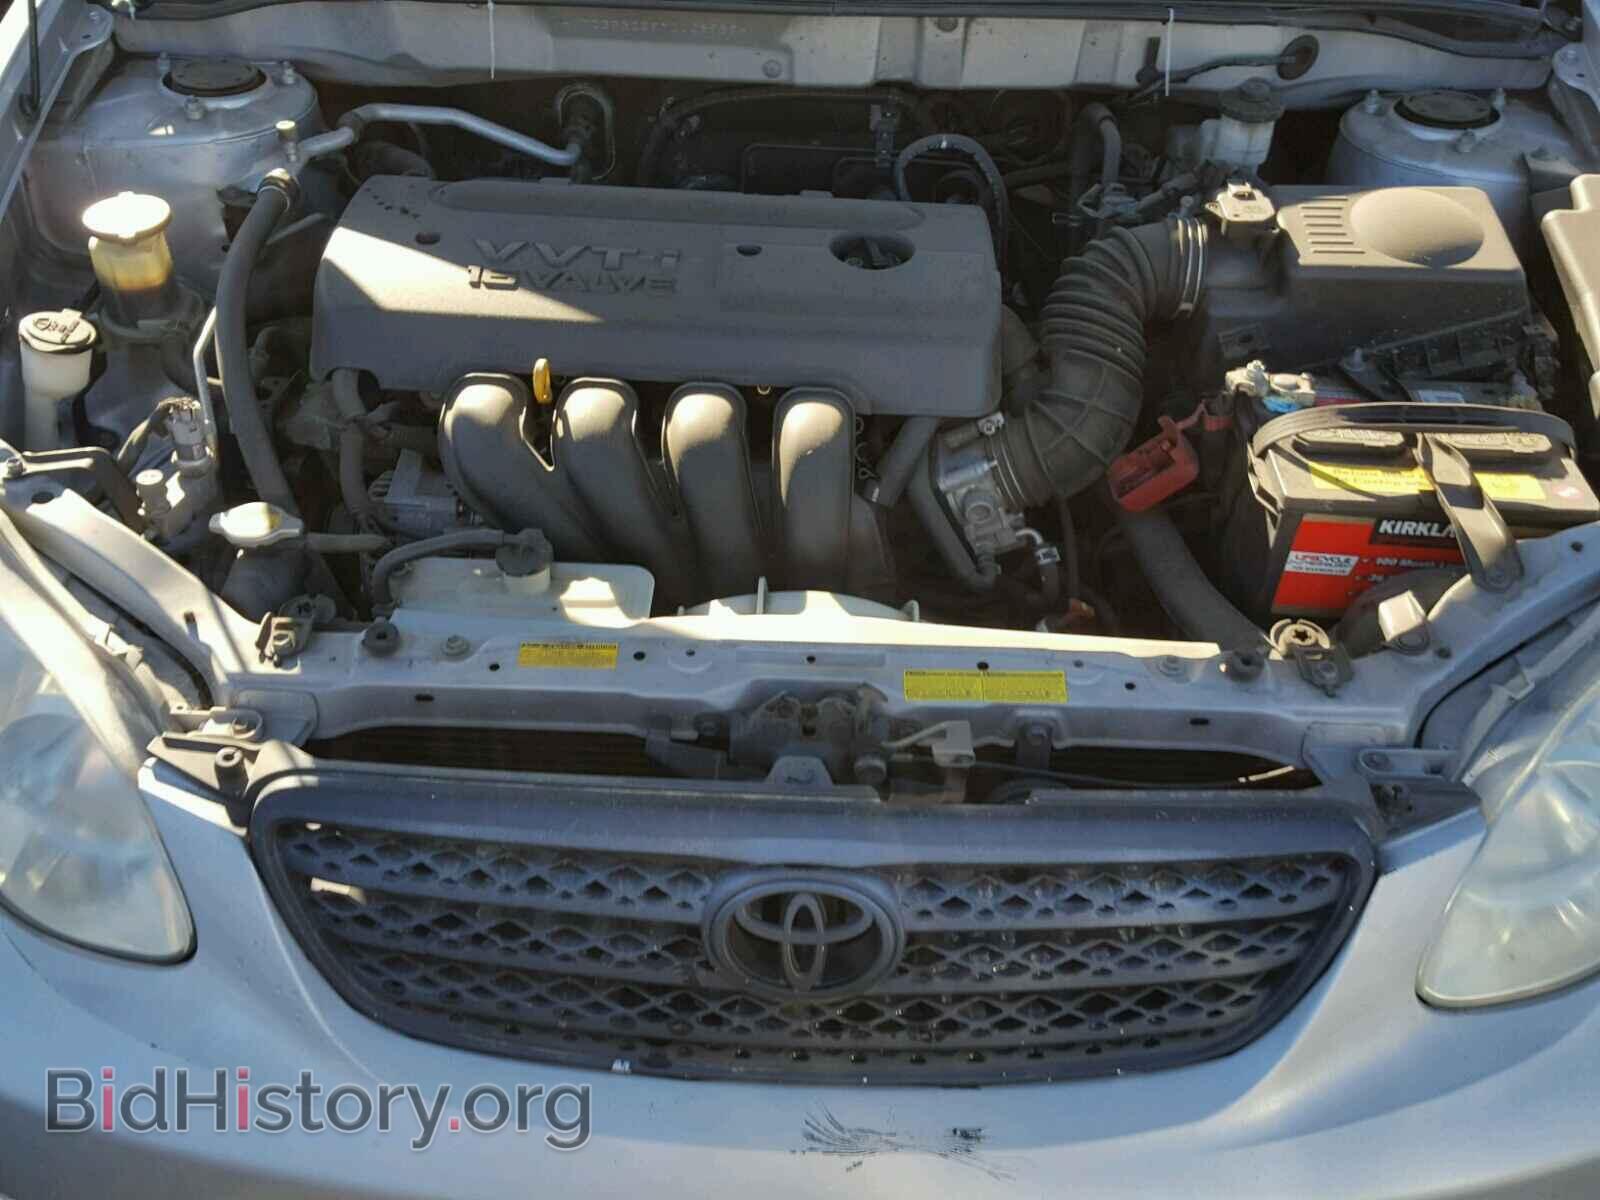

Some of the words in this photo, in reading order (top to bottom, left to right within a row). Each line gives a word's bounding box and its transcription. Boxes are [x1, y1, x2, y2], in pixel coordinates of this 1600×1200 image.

[468, 265, 519, 291] 16
[527, 270, 679, 294] VALVE
[1379, 519, 1457, 538] KIRKLA
